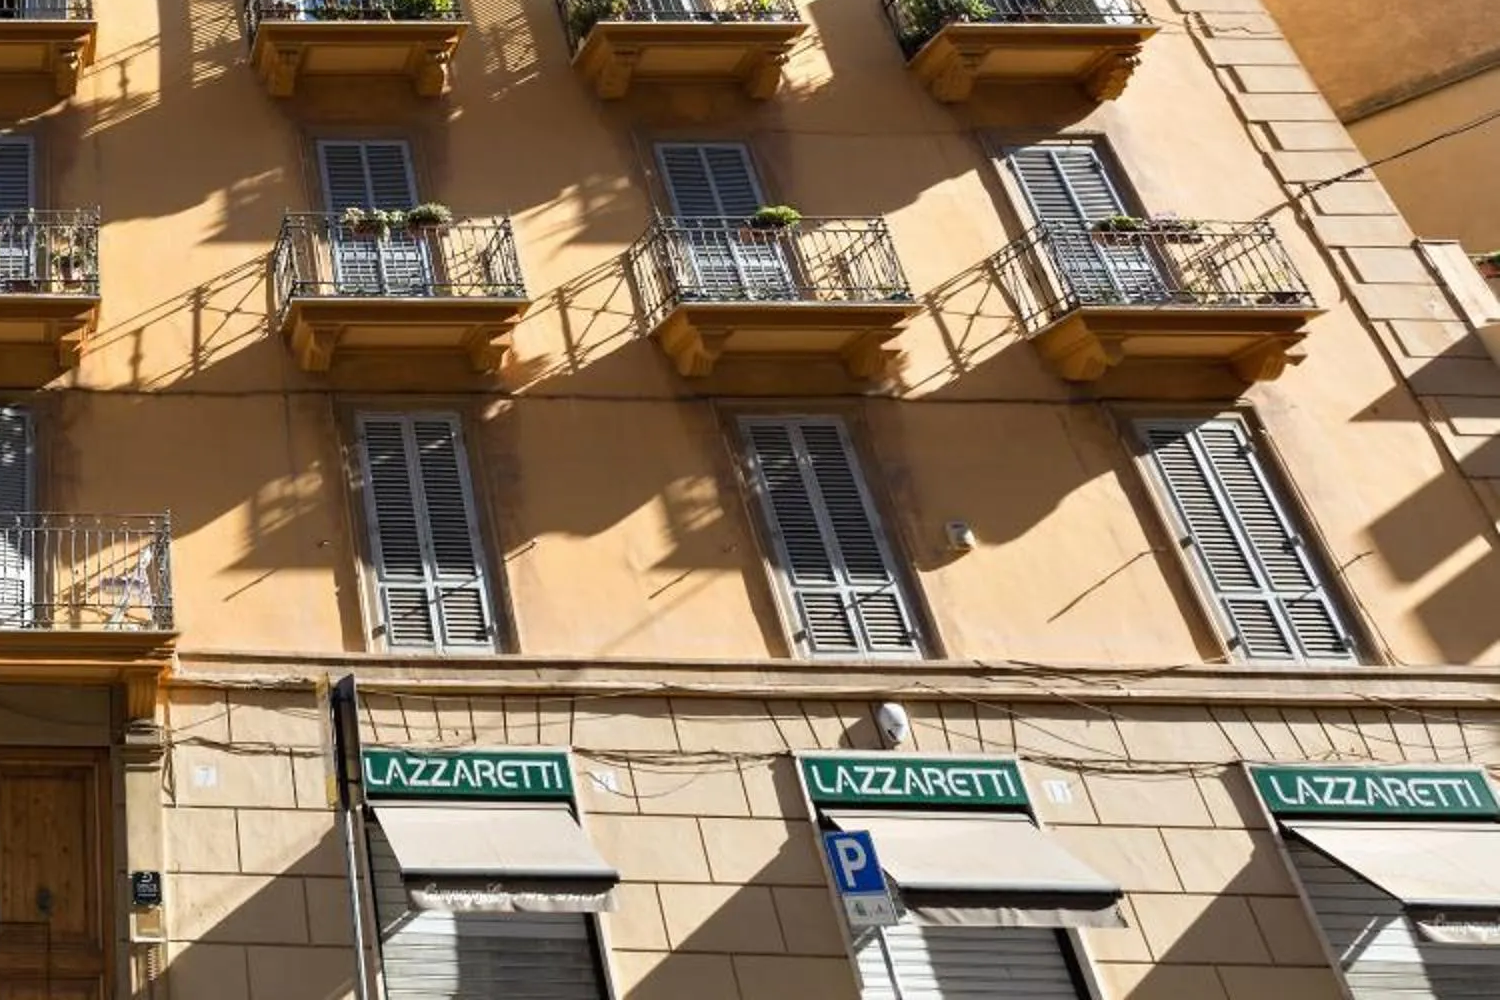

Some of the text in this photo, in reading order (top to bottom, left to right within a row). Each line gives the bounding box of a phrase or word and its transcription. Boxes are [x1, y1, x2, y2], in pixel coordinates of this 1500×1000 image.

[364, 757, 564, 790] LAZZARETTI
[811, 764, 1019, 798] LAZZARETTI
[1269, 774, 1483, 808] LAZZARETTI
[834, 837, 868, 889] P
